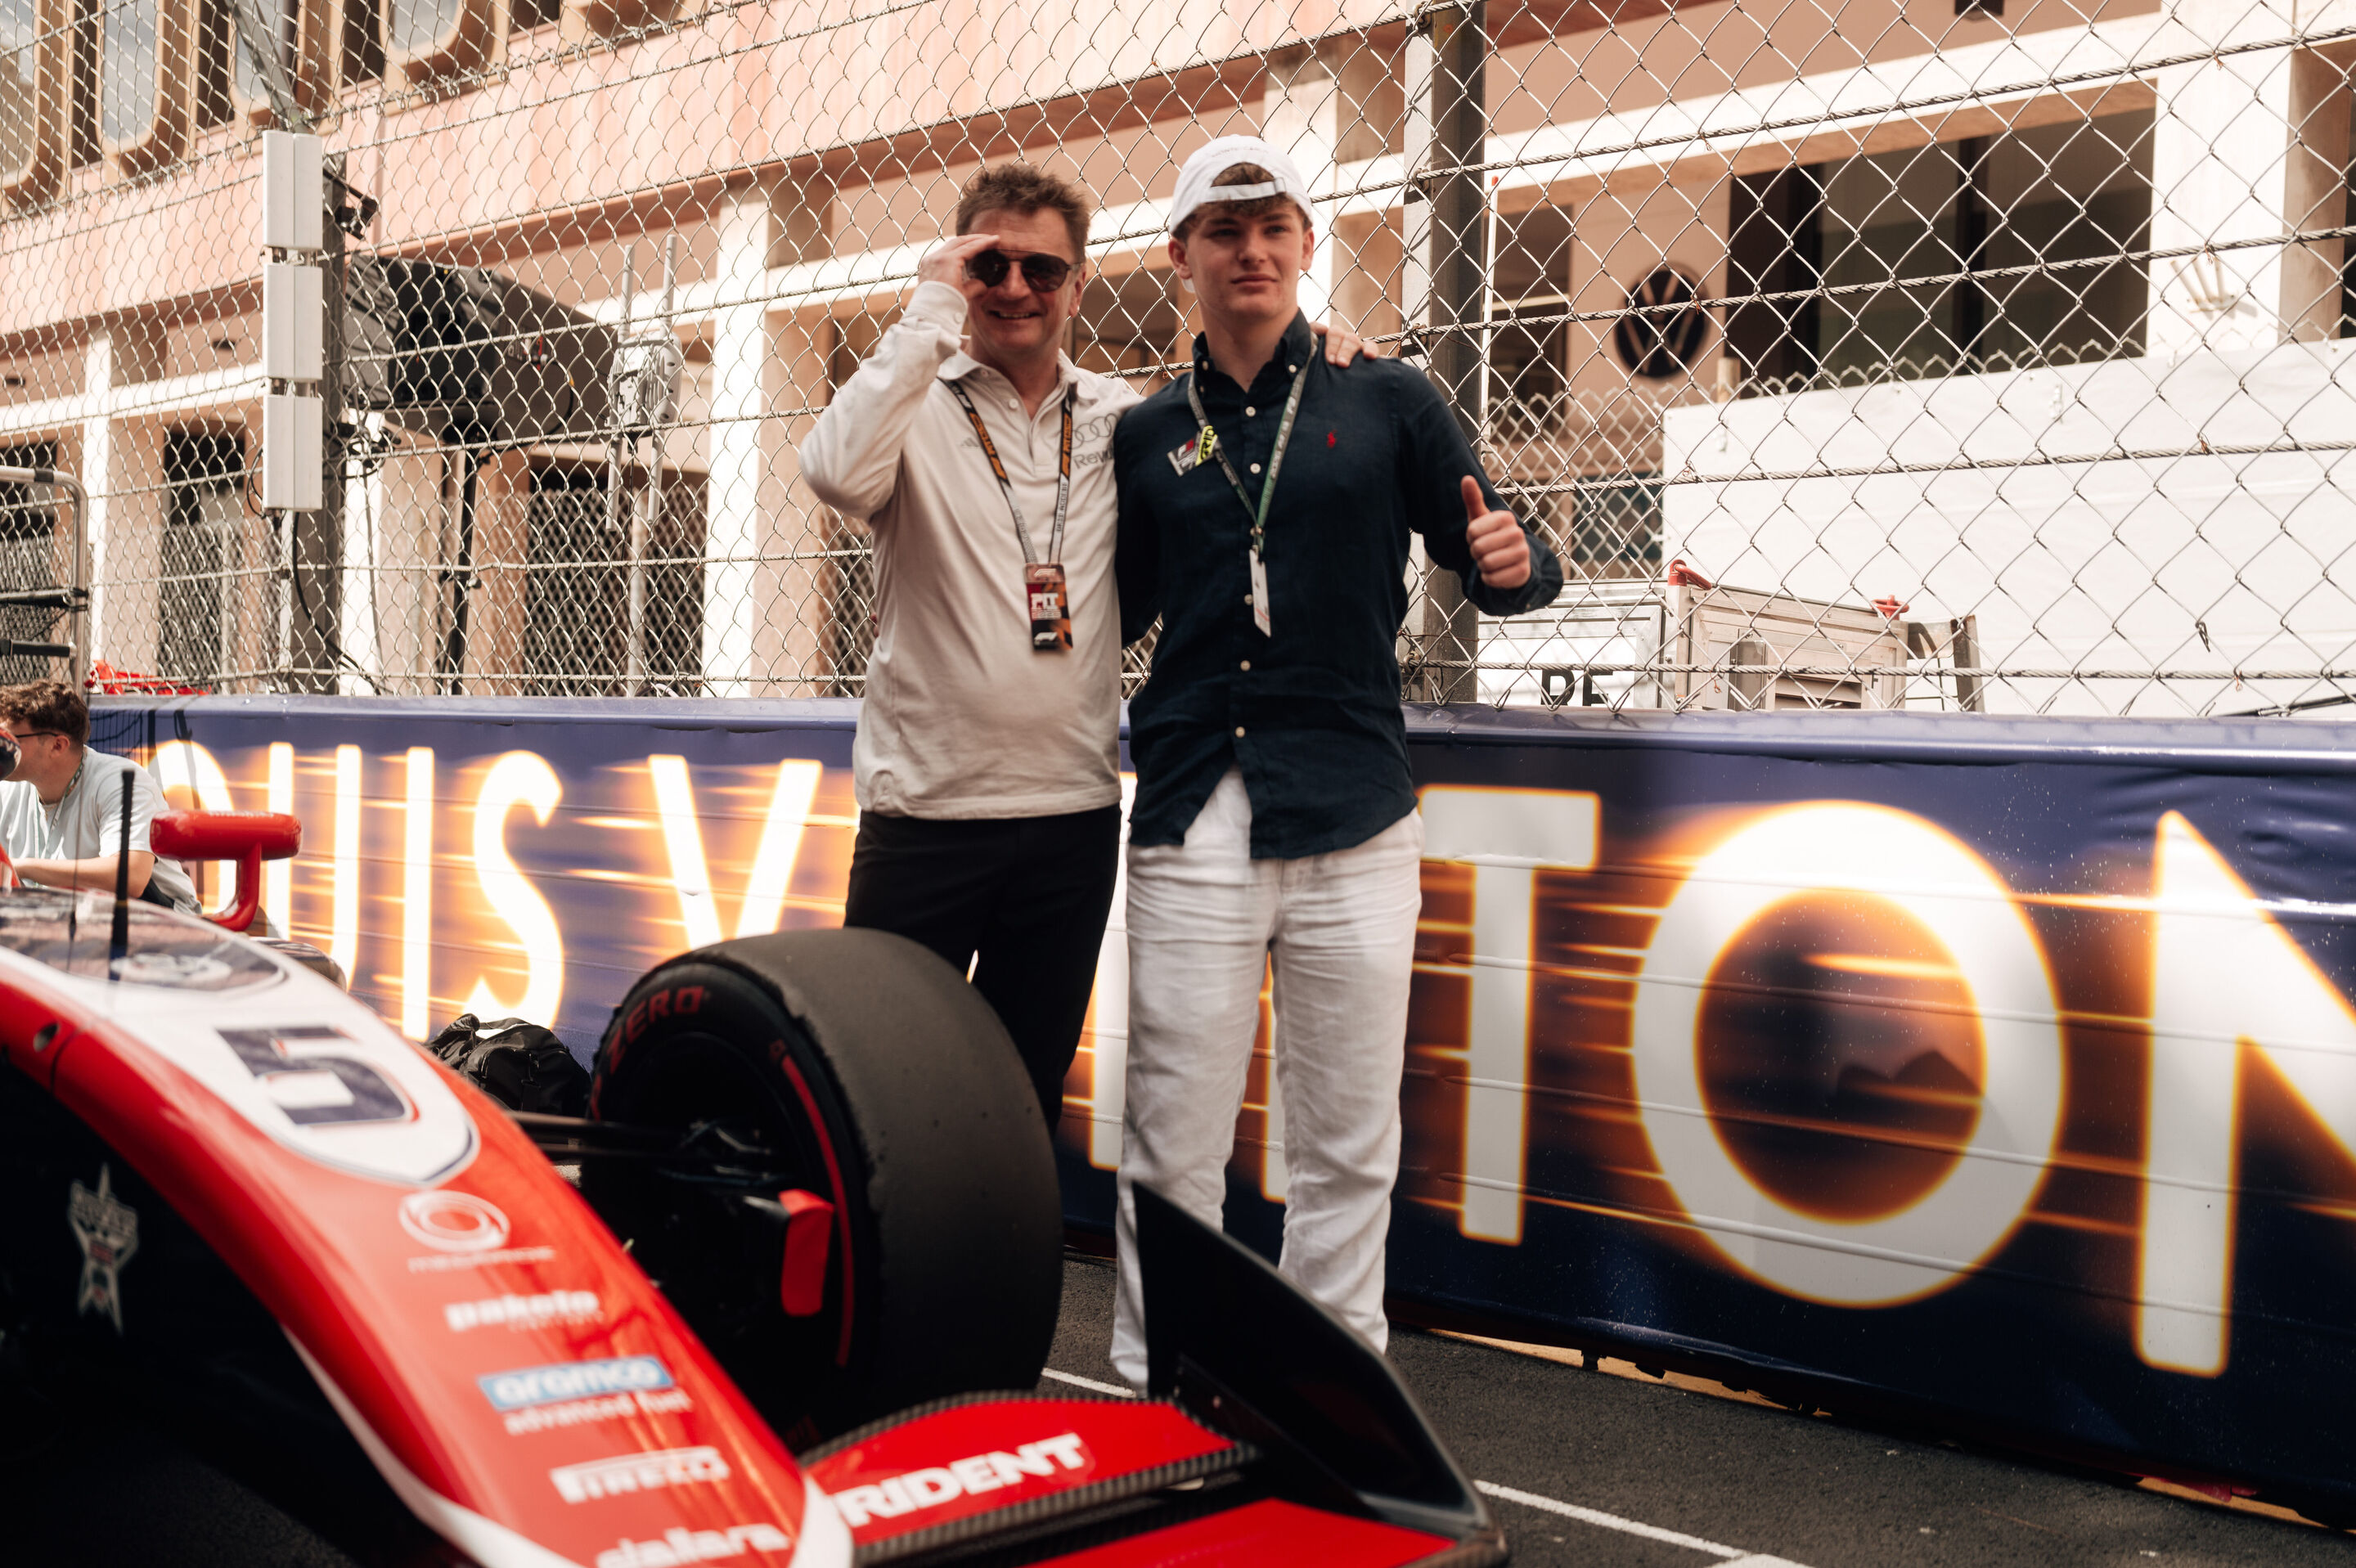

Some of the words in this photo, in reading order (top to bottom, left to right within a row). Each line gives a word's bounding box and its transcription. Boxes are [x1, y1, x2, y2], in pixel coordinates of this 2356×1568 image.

[144, 739, 564, 1041] OUIS
[216, 1026, 420, 1126] 5
[606, 986, 705, 1075] ZERO
[493, 1359, 661, 1404] aramco
[504, 1393, 636, 1436] advanced
[635, 1388, 693, 1413] fuel
[832, 1432, 1086, 1528] RIDENT
